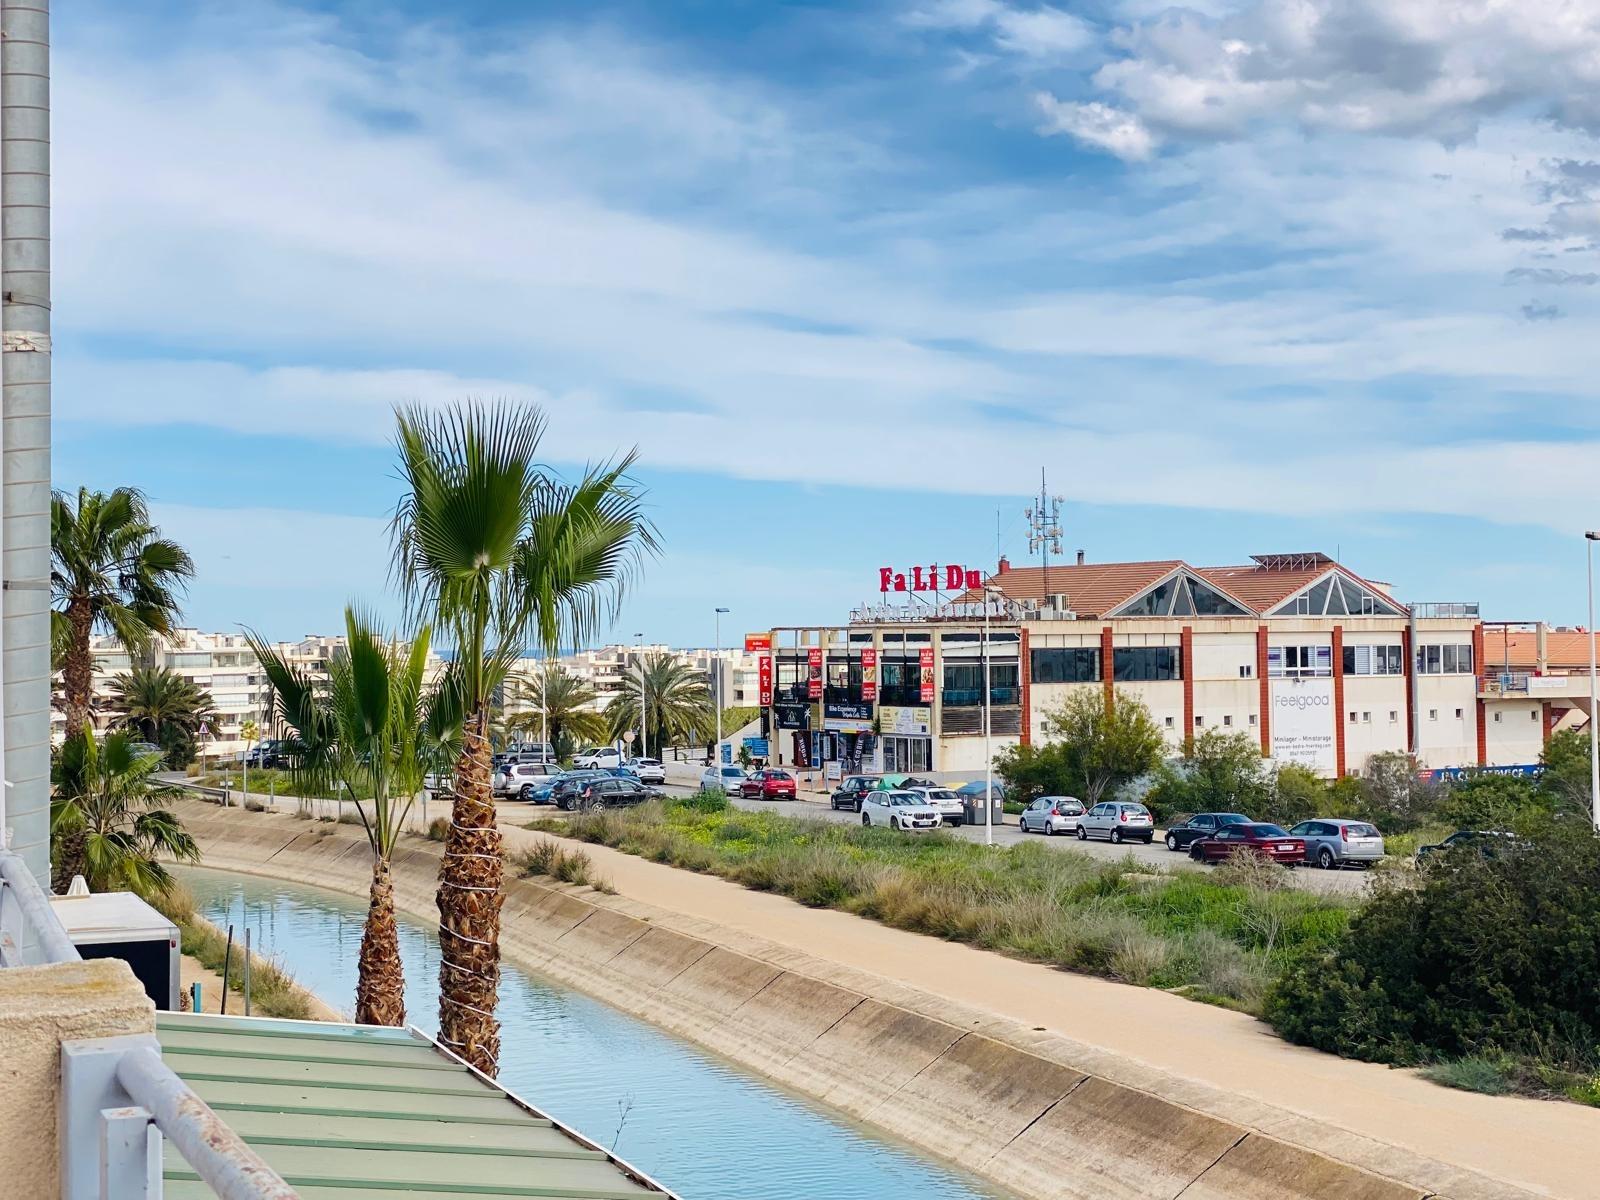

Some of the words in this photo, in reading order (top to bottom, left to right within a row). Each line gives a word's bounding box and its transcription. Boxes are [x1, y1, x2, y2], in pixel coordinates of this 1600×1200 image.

[880, 567, 906, 592] Fa
[913, 565, 937, 591] Li
[946, 565, 982, 589] Du
[762, 658, 770, 670] FA
[762, 675, 769, 687] LI
[762, 692, 770, 703] DU
[1275, 695, 1329, 710] Feelgood
